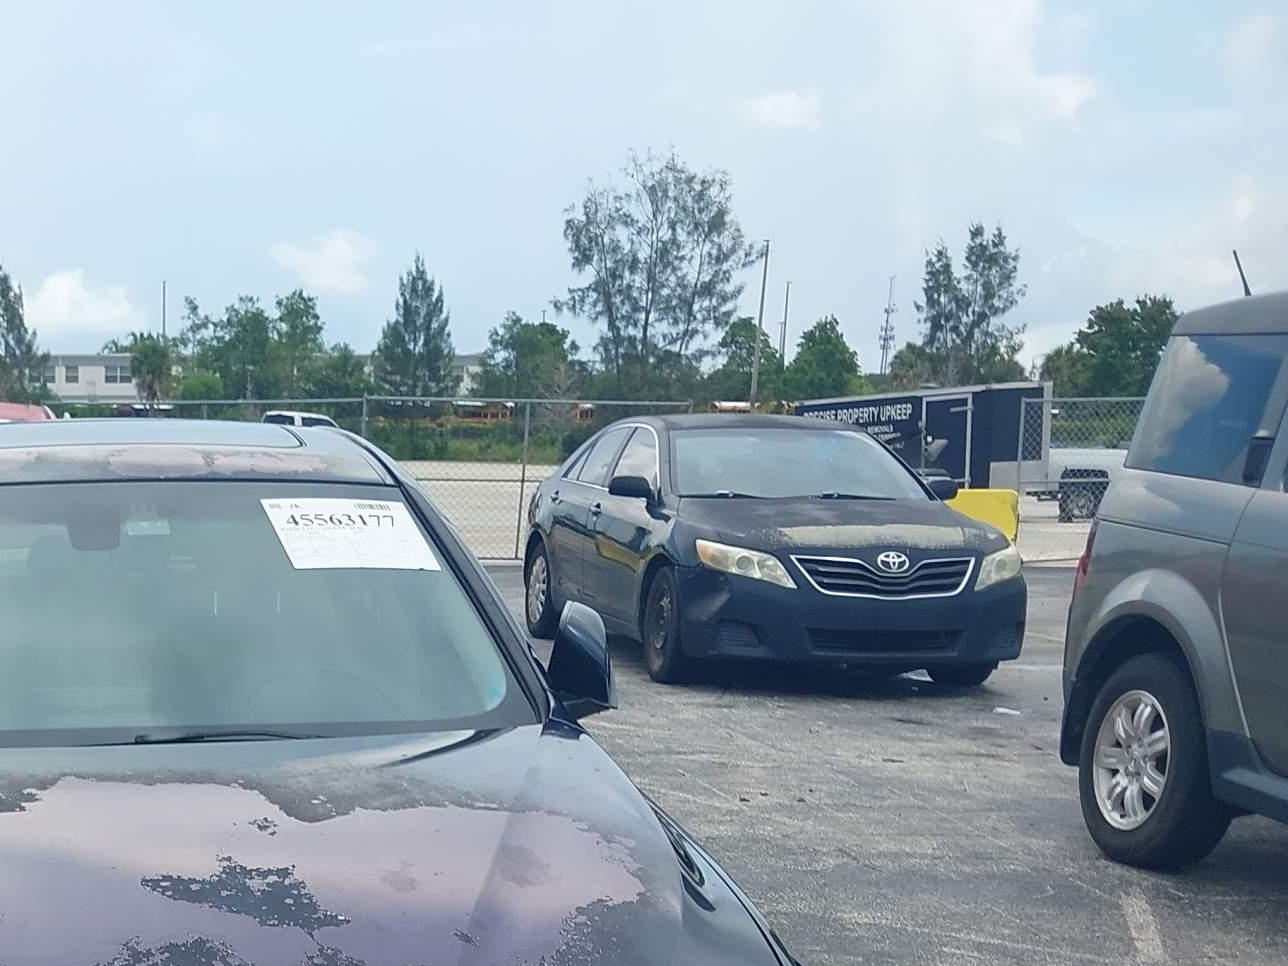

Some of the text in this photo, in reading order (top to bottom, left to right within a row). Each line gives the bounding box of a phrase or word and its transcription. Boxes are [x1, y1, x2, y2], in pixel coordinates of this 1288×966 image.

[837, 405, 879, 424] PROPERTY
[880, 403, 912, 421] UPKEEP
[285, 513, 395, 528] 45563177
